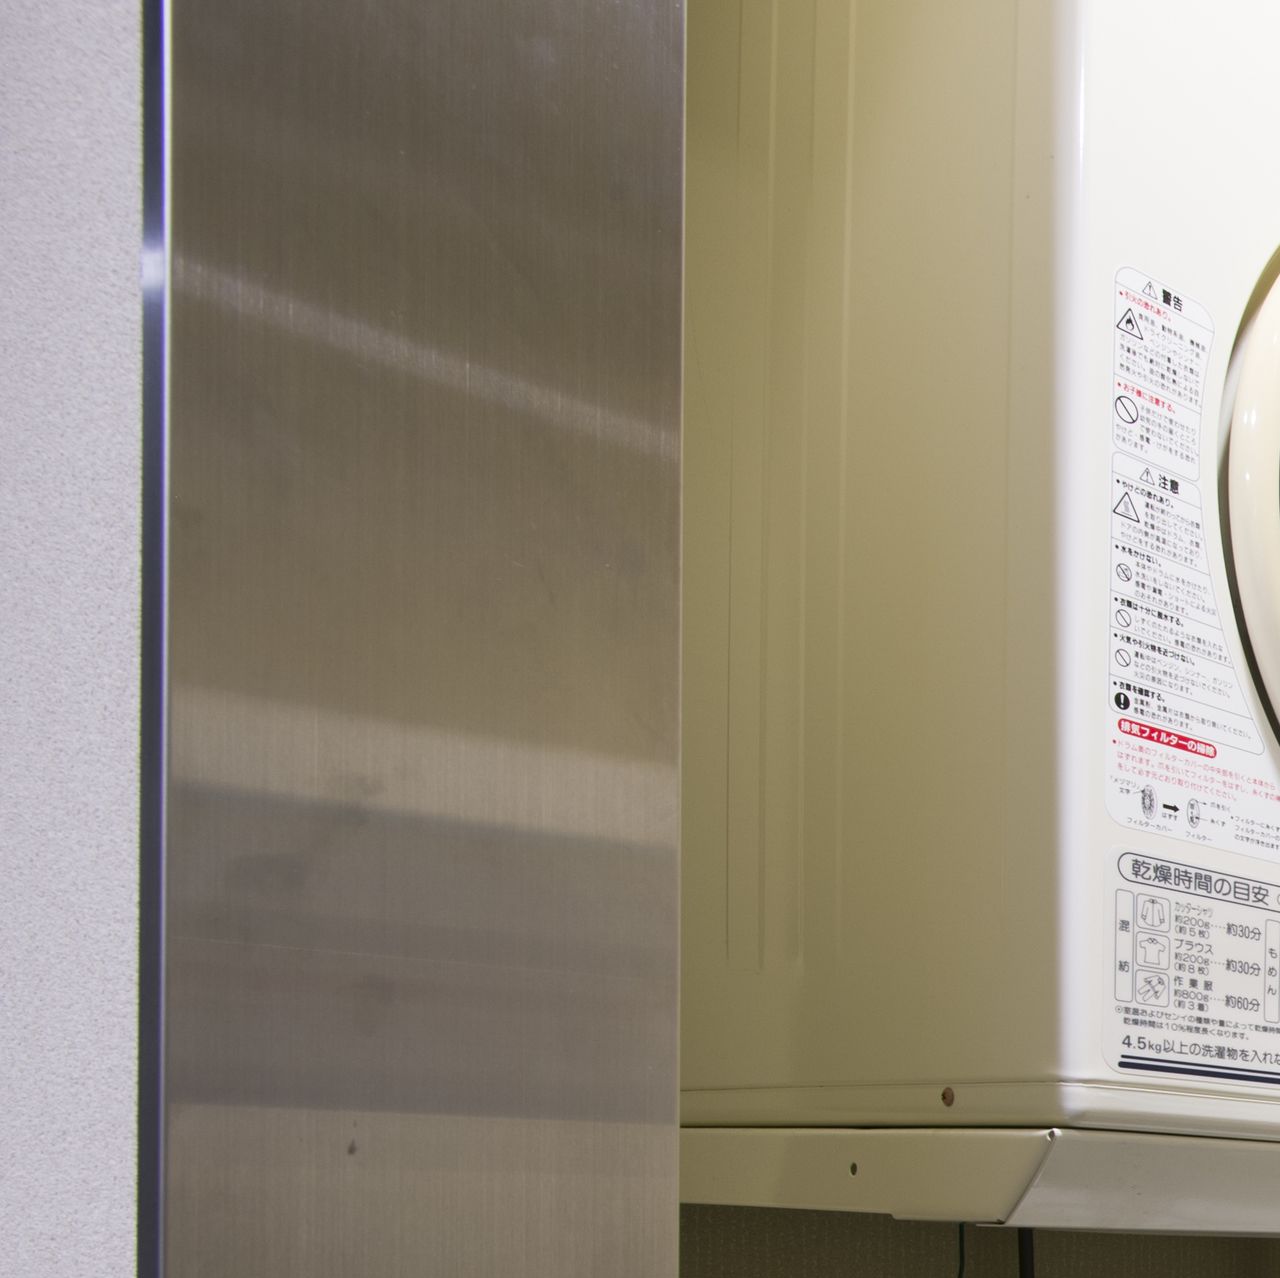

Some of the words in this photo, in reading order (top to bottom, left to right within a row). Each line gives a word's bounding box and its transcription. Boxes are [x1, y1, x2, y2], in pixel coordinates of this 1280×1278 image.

[1162, 289, 1183, 312] 警告
[1158, 474, 1179, 494] 注意
[1131, 858, 1269, 906] 乾燥時間の目安
[1226, 922, 1261, 941] 約30分
[1225, 958, 1261, 977] 約30分
[1225, 995, 1260, 1012] 約60分
